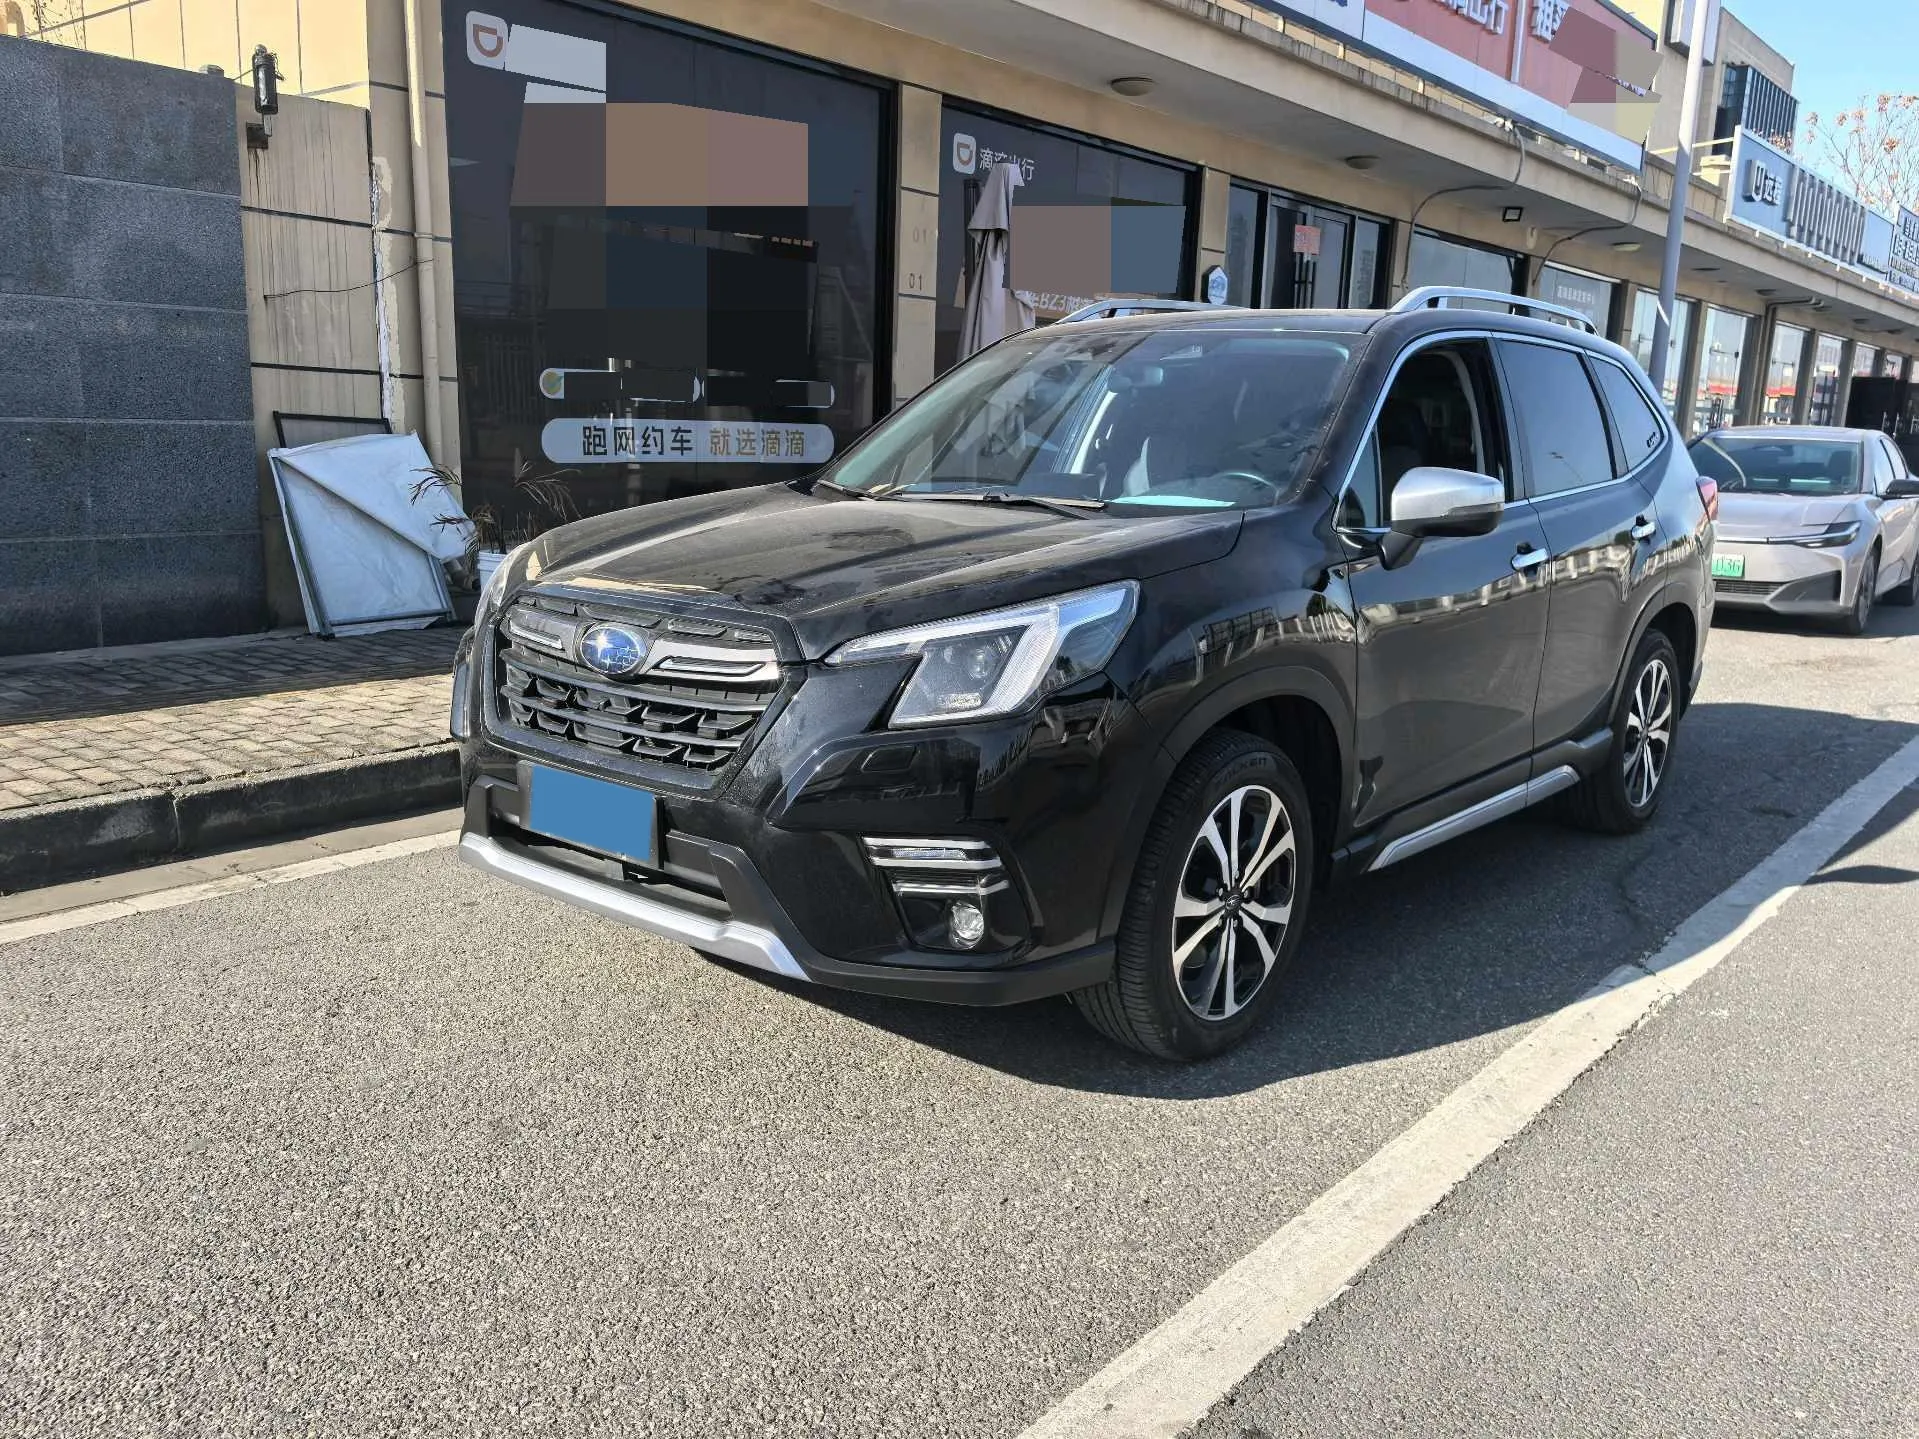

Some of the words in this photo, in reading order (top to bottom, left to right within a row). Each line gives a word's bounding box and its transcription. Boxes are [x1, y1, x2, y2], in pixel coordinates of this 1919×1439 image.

[582, 425, 693, 457] 跑网约车
[709, 428, 805, 458] 就选滴滴
